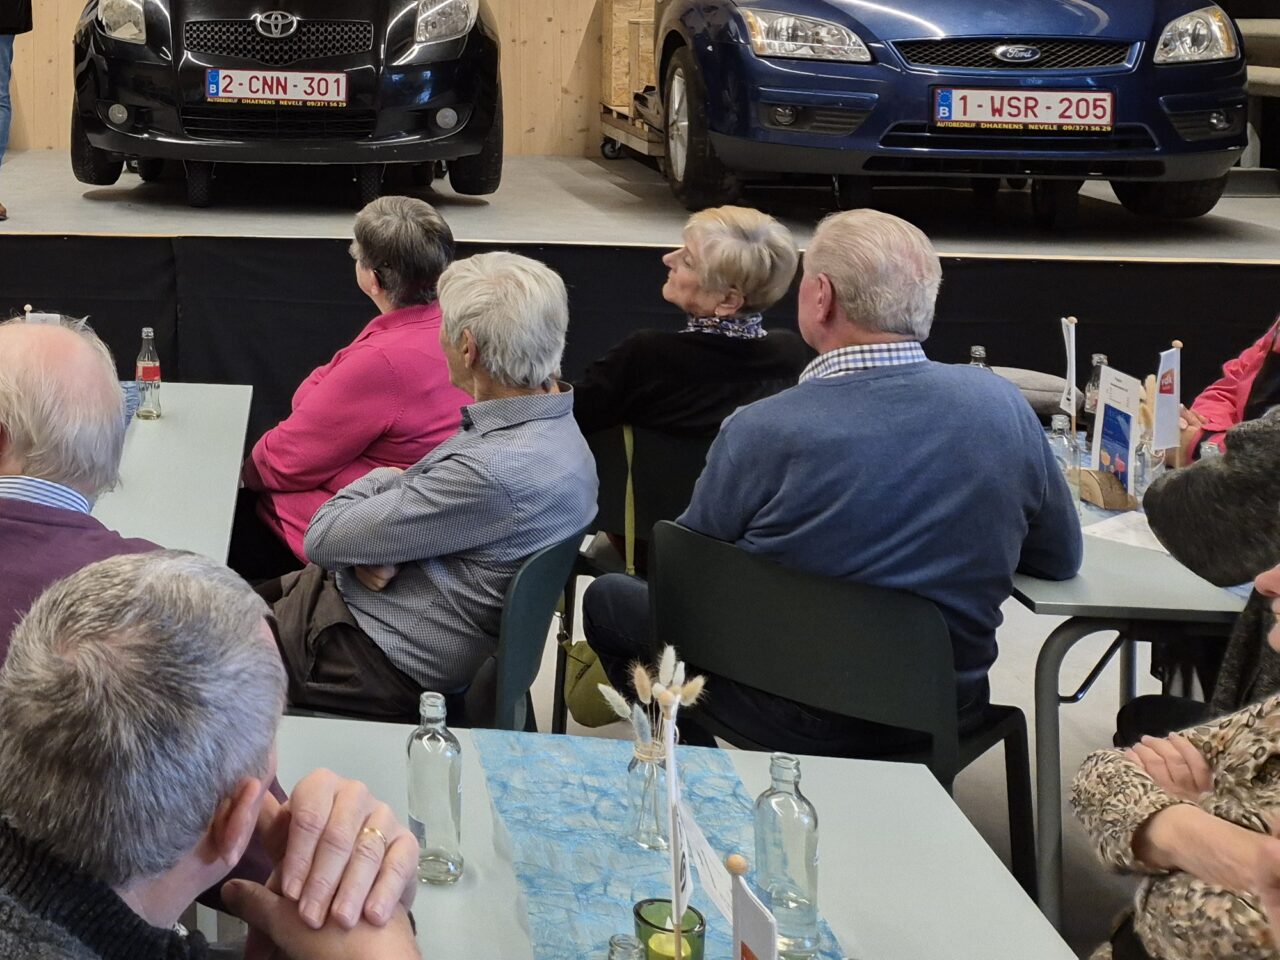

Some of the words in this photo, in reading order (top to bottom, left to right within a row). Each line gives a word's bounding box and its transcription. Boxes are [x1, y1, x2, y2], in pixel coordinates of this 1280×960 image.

[1007, 47, 1032, 58] Ford
[209, 84, 217, 94] B
[221, 74, 341, 97] 2-CNN-301
[939, 106, 950, 118] B
[959, 95, 1107, 120] 1-WSR-205
[981, 122, 1024, 130] DHAENENS
[1028, 123, 1058, 131] NEVELE
